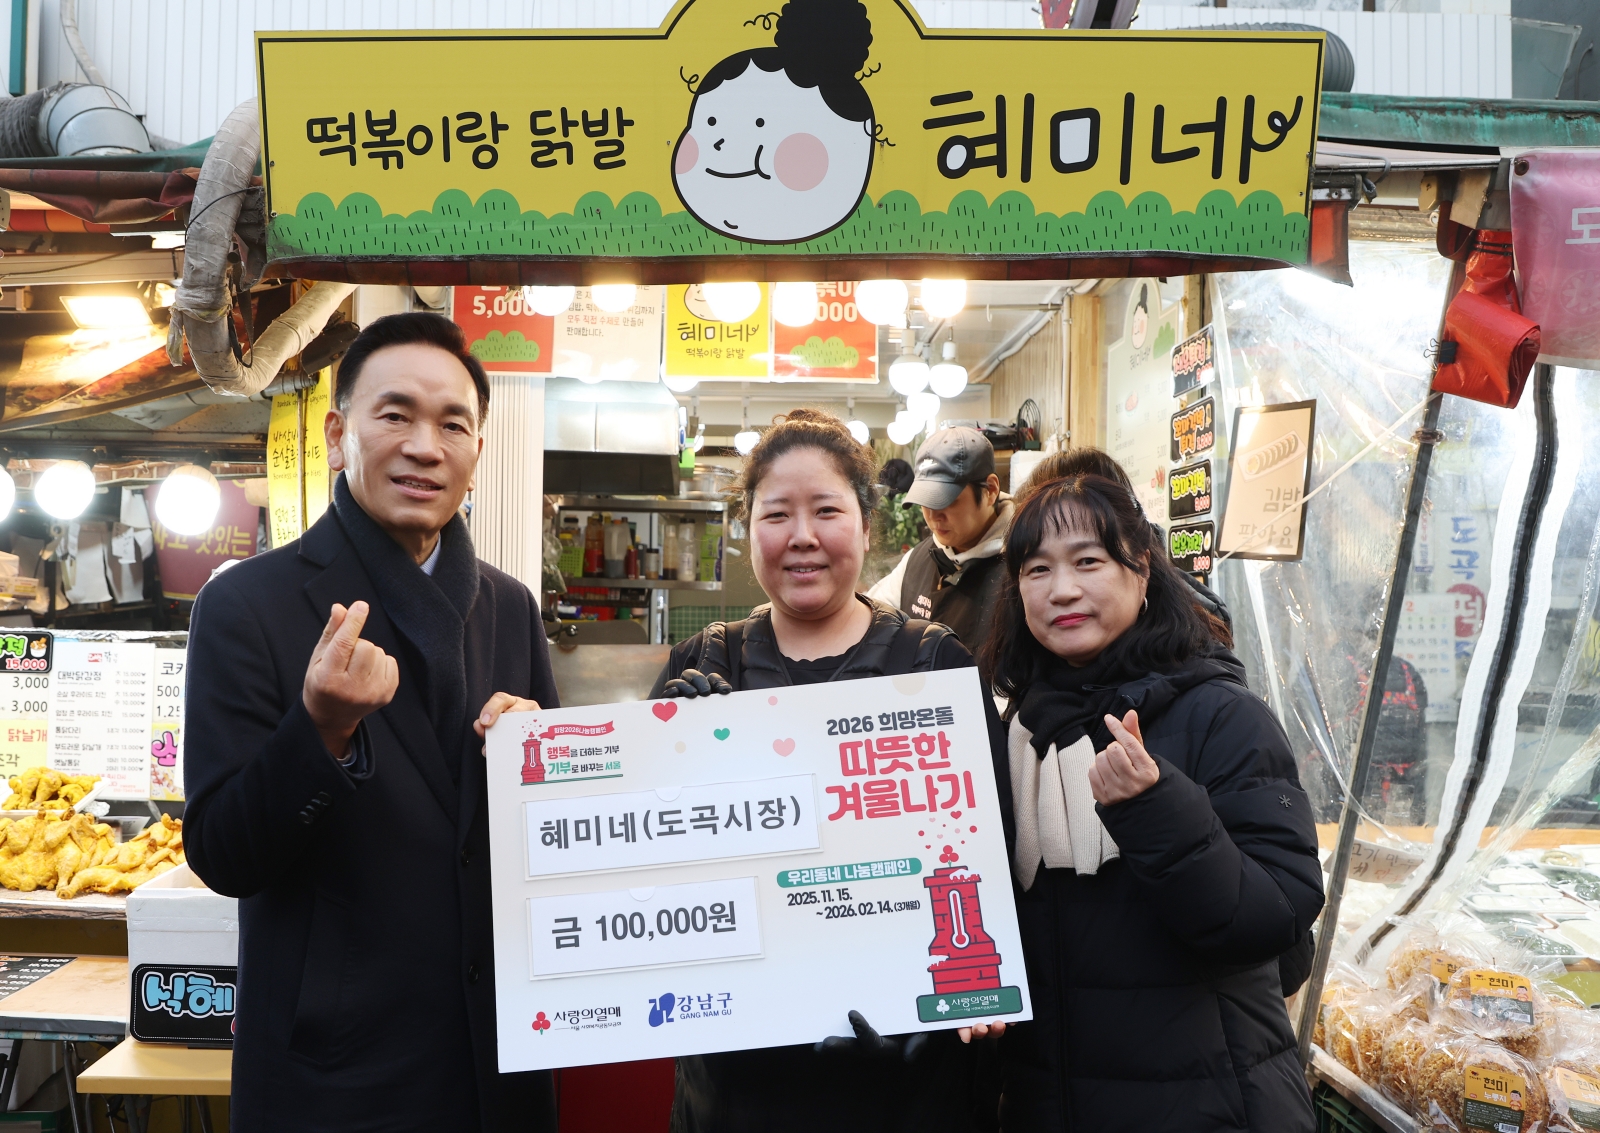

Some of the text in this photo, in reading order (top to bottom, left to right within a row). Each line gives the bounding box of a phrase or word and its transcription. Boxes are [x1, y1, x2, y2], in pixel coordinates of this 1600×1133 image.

[307, 107, 634, 170] 떡볶이랑 닭발
[923, 91, 1303, 185] 혜미네
[567, 315, 644, 327] 모두 직접 수제로 만들어
[567, 327, 604, 337] 판매합니다.
[677, 323, 759, 342] 혜미네
[686, 347, 745, 359] 떡볶이랑 닭발
[1174, 407, 1204, 439] 꼬마김밥
[1172, 468, 1205, 499] 꼬마김밥
[1263, 487, 1300, 513] 김밥
[1239, 523, 1293, 549] 팔아요
[6, 658, 47, 671] 15,000
[13, 676, 48, 690] 3,000
[157, 686, 180, 697] 500
[11, 700, 48, 714] 3,000
[827, 705, 955, 736] 2026 희망온돌
[8, 728, 47, 742] 닭날개
[547, 745, 620, 760] 행복을 더하는 기부
[839, 730, 952, 777] 따뜻한
[548, 761, 621, 775] 기부로 바꾸는 서울
[825, 771, 976, 822] 겨울나기
[539, 795, 802, 850] 혜미네(도곡시장)
[787, 859, 912, 885] 우리동네 나눔캠페인
[551, 901, 737, 949] 금 100,000원
[1489, 977, 1514, 988] 현미
[145, 973, 235, 1014] 식혜
[677, 992, 734, 1013] 강남구
[951, 994, 999, 1007] 사랑의열매
[554, 1006, 622, 1025] 사랑의열매
[1483, 1077, 1508, 1093] 현미
[1484, 1091, 1507, 1102] 누룽지
